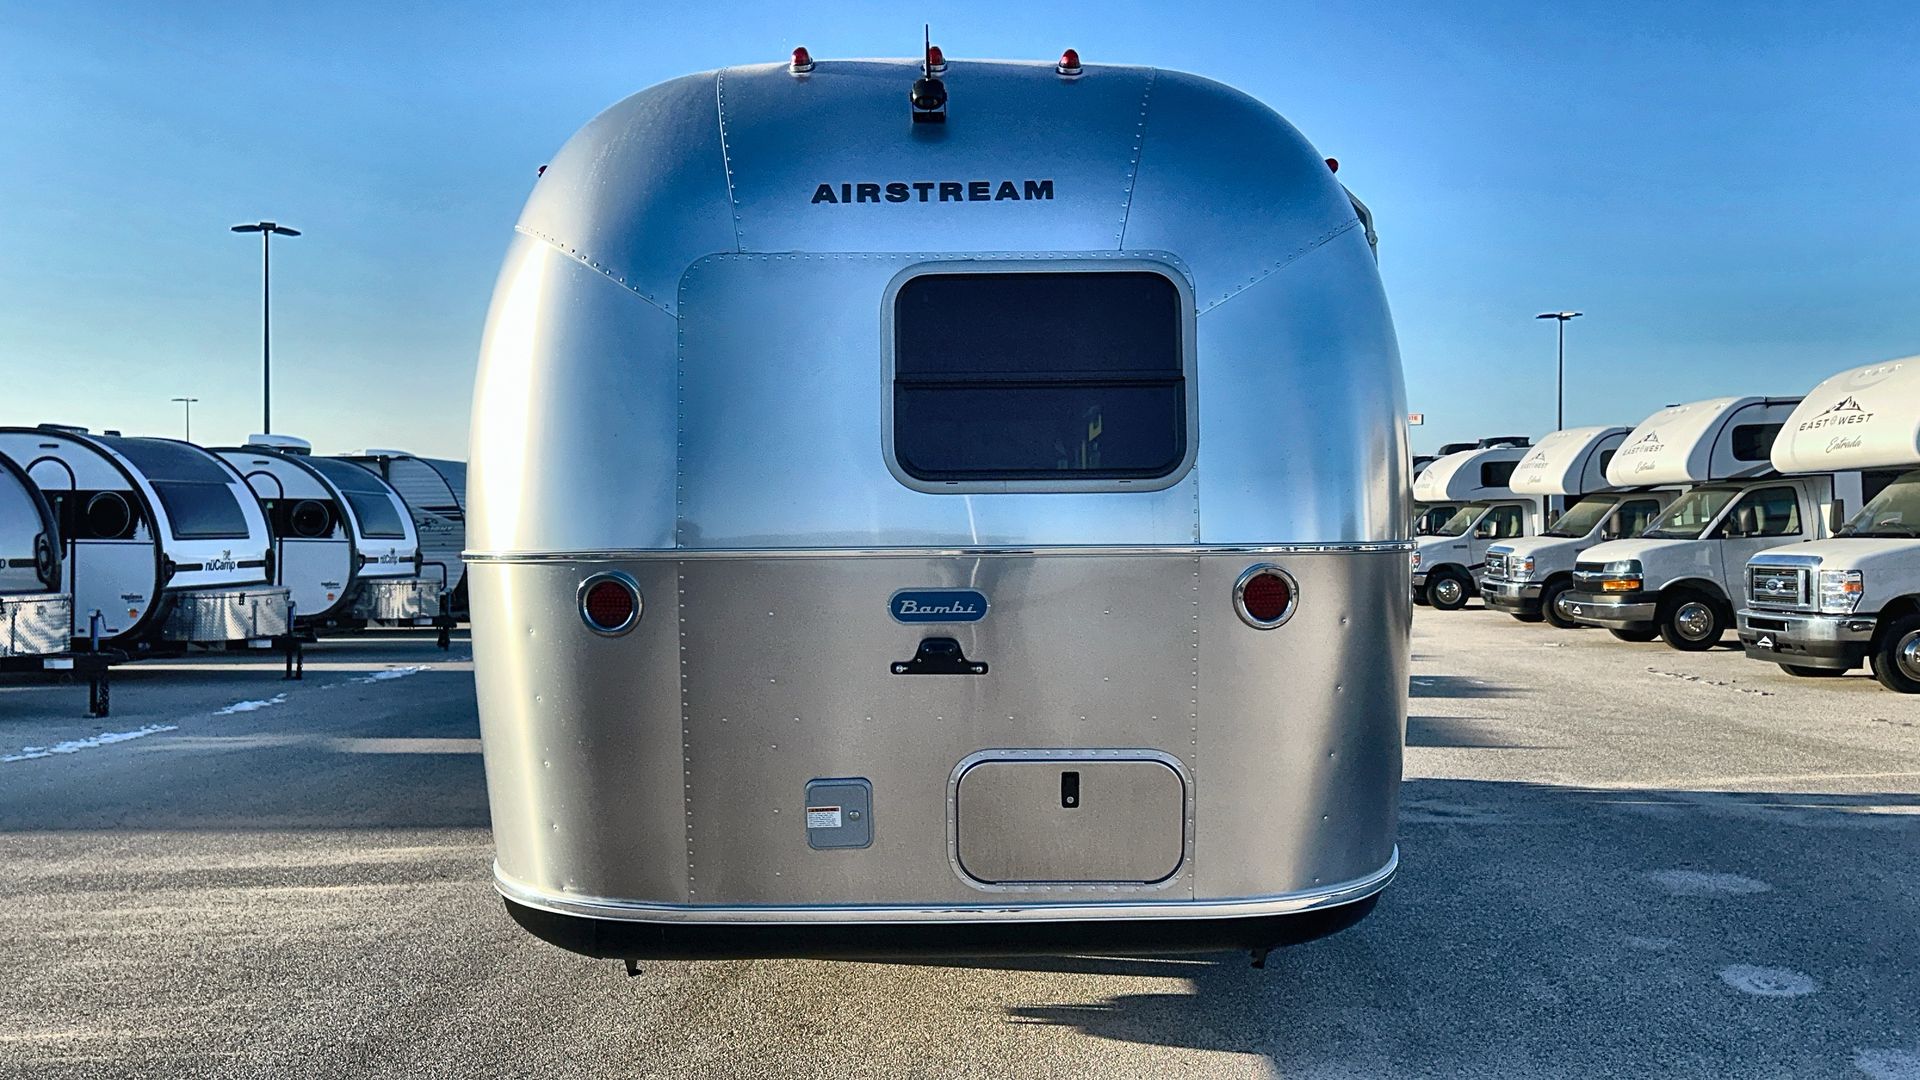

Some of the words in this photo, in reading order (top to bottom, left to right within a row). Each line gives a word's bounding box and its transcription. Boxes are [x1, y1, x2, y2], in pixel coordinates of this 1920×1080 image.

[811, 180, 1054, 203] AIRSTREAM
[1800, 419, 1829, 431] EAST
[1839, 413, 1874, 425] WEST
[1825, 435, 1863, 453] Entrada
[899, 600, 977, 614] Bambi
